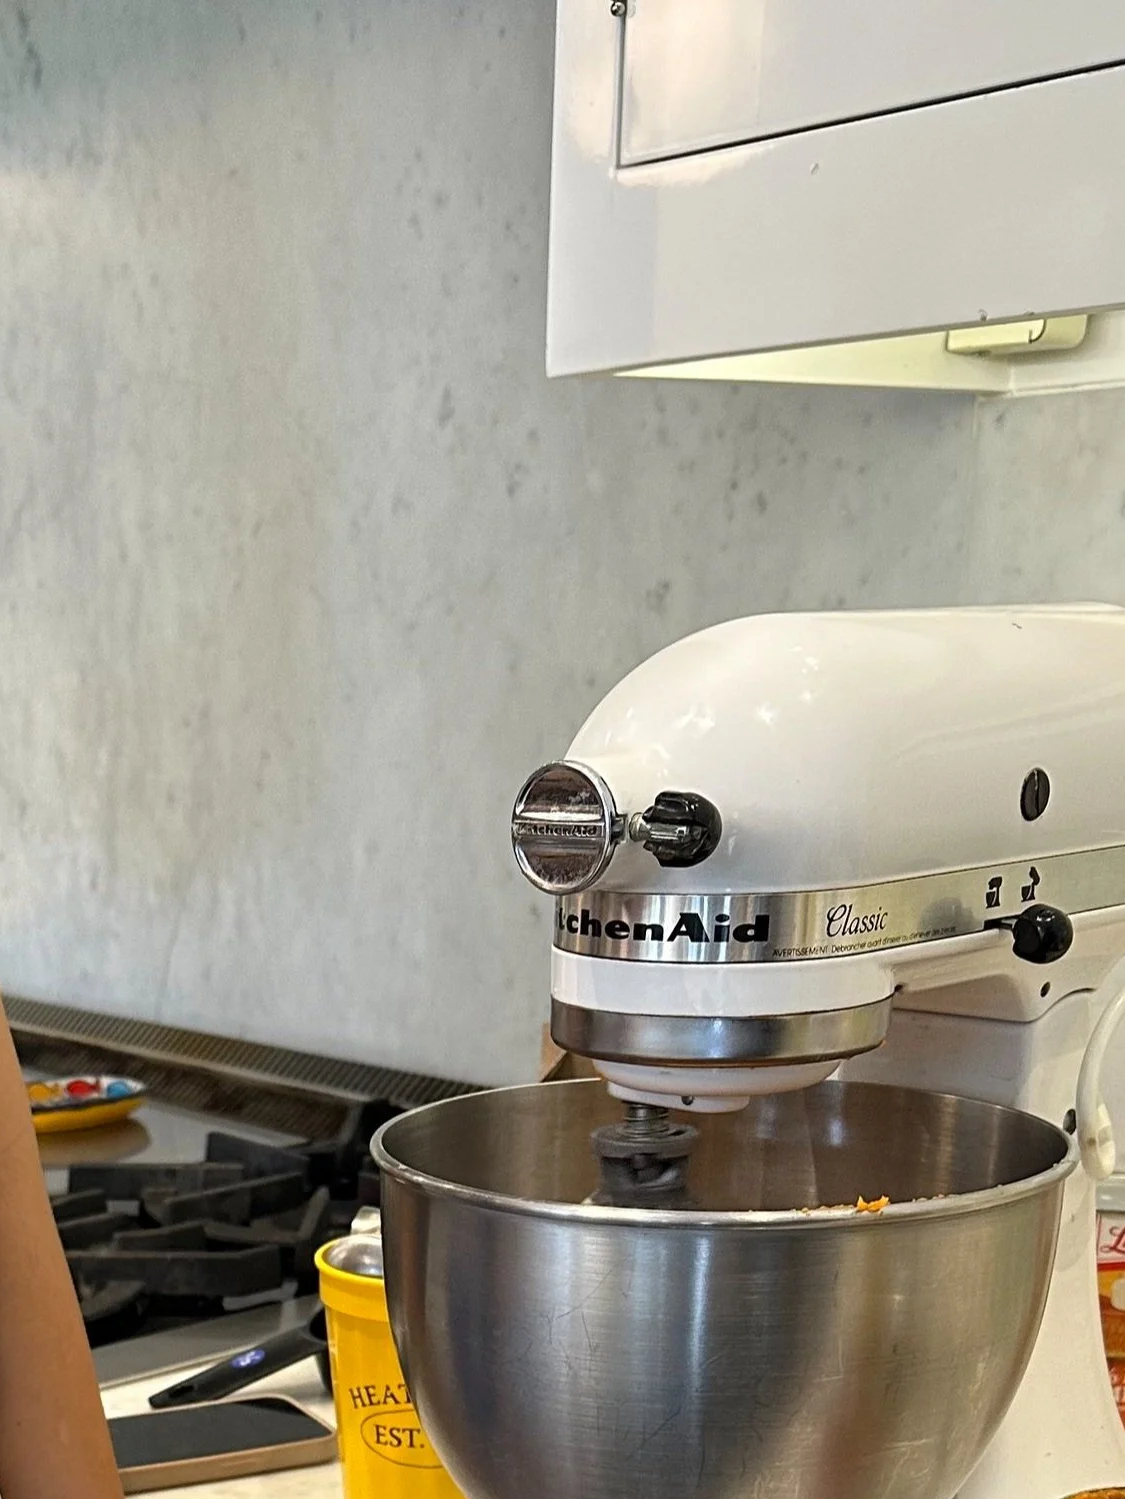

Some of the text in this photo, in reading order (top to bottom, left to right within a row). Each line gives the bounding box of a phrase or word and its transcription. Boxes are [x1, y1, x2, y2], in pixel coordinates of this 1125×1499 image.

[556, 907, 770, 943] tchenAid
[826, 903, 889, 938] Classic
[374, 1423, 425, 1449] EST.
